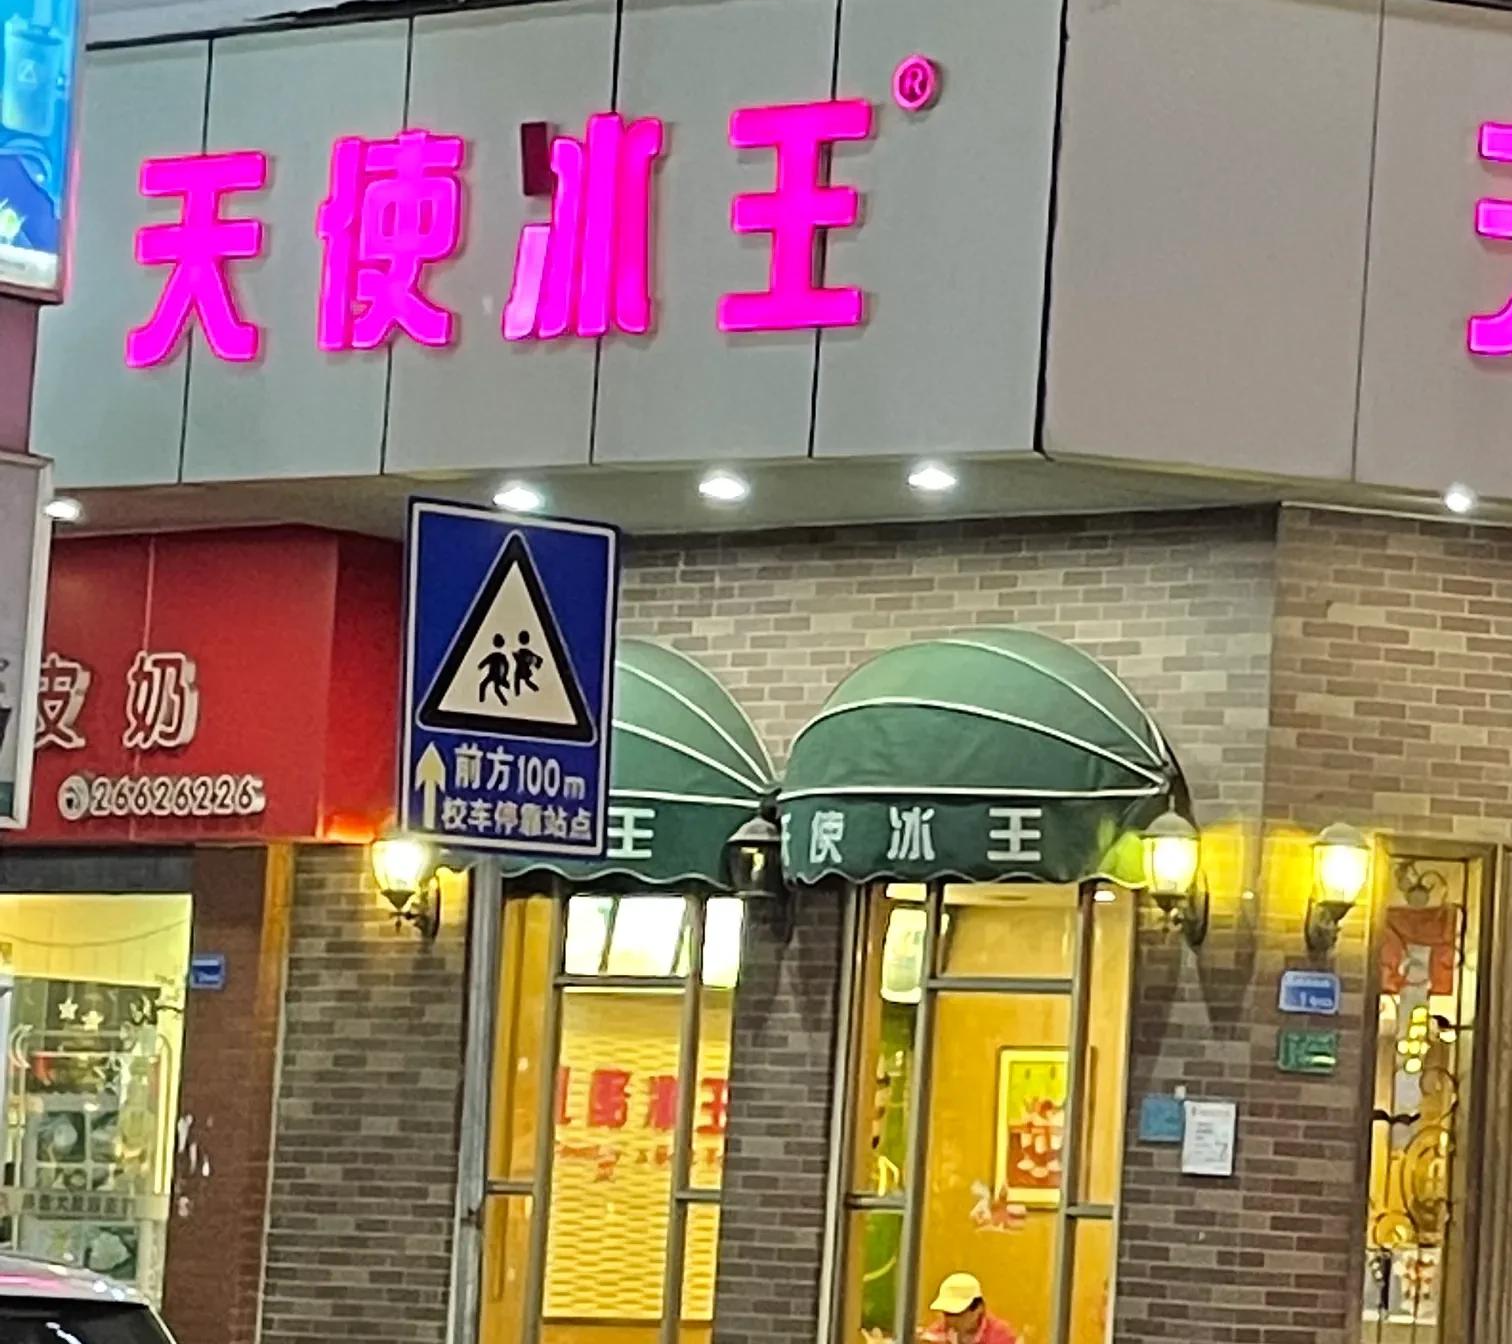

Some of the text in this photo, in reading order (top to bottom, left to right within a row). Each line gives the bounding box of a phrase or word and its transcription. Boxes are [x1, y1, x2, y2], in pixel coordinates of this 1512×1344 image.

[125, 99, 873, 368] 天使冰王
[90, 775, 264, 816] 26626226
[441, 795, 592, 841] 校车停靠站点
